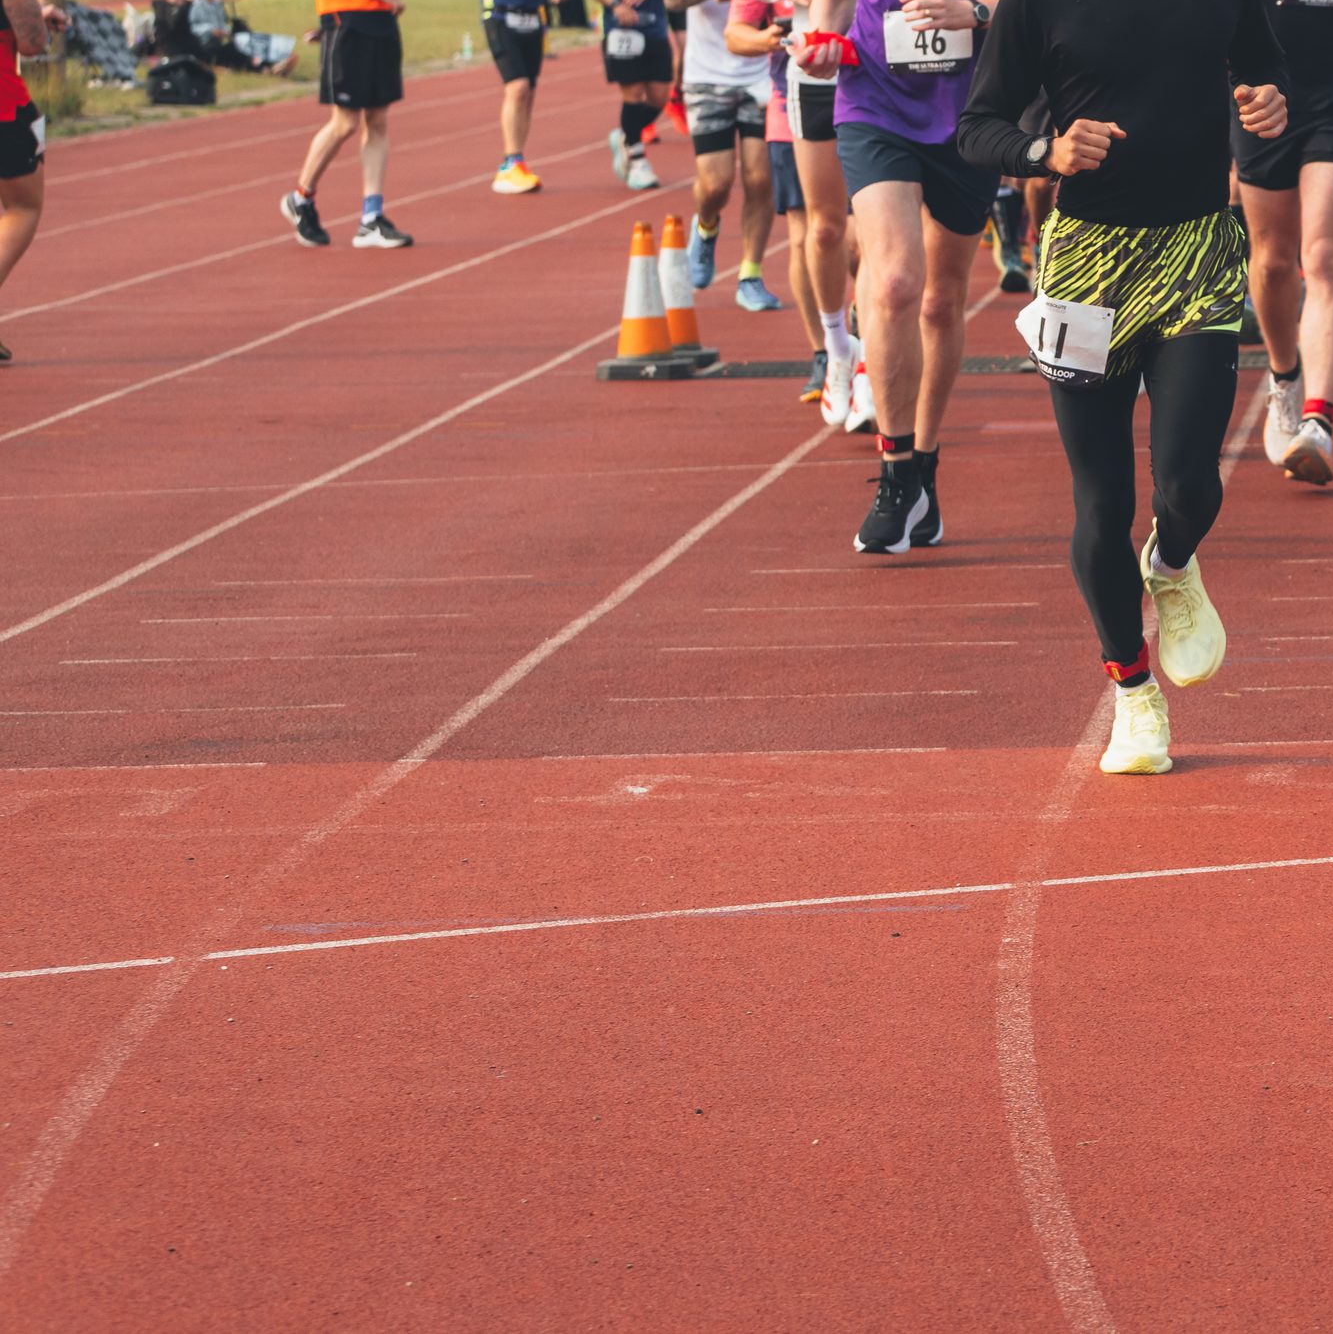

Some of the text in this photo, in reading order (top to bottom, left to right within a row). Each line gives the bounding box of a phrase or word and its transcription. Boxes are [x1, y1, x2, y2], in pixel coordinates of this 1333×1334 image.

[914, 29, 946, 55] 46
[1038, 317, 1068, 359] 11
[1053, 368, 1076, 379] LOOP
